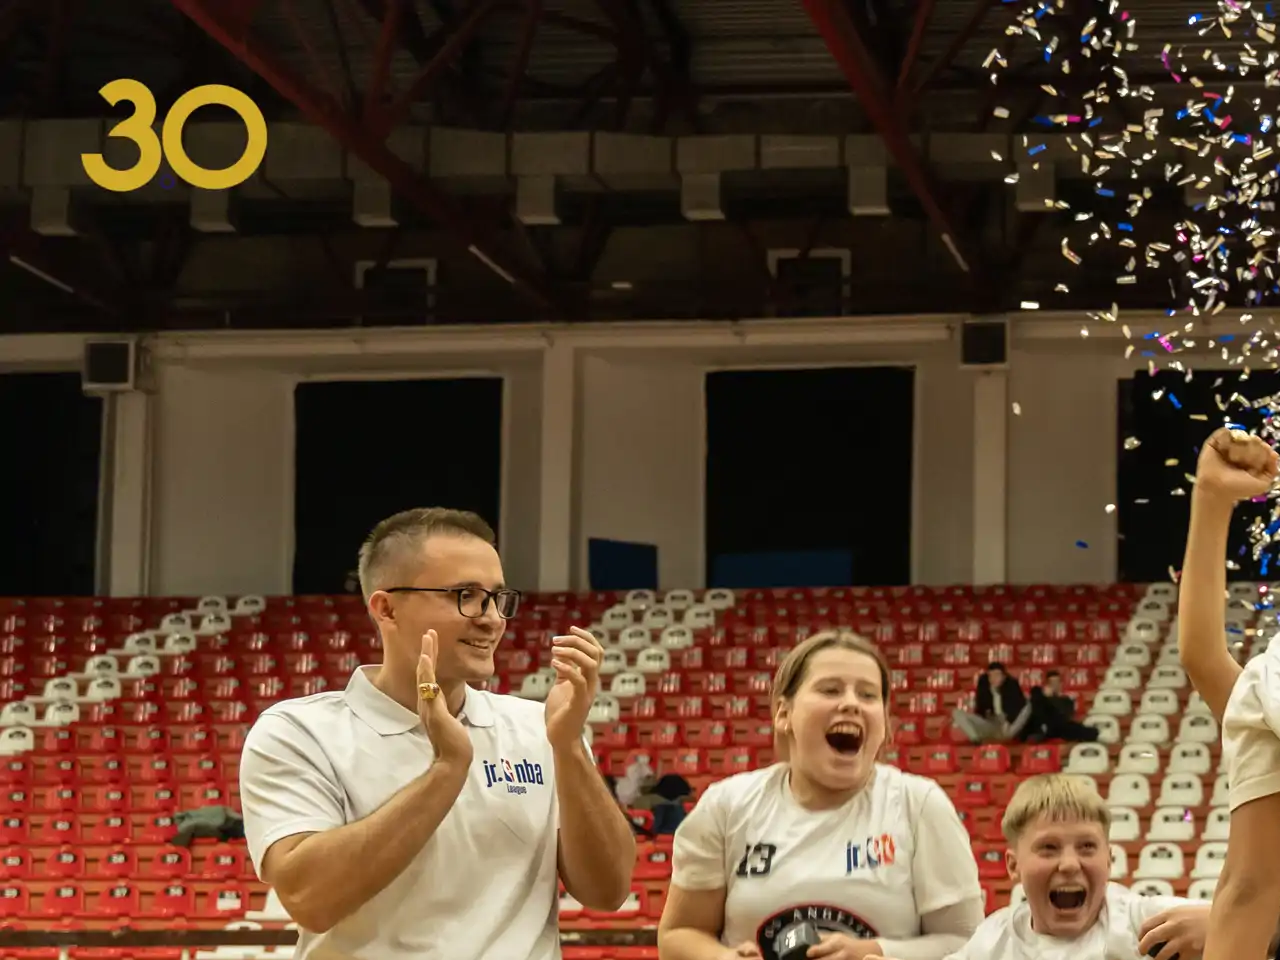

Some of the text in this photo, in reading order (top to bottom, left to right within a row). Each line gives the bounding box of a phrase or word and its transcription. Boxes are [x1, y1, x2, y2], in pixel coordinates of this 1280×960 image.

[483, 758, 544, 787] jr. nba
[737, 843, 777, 877] 13
